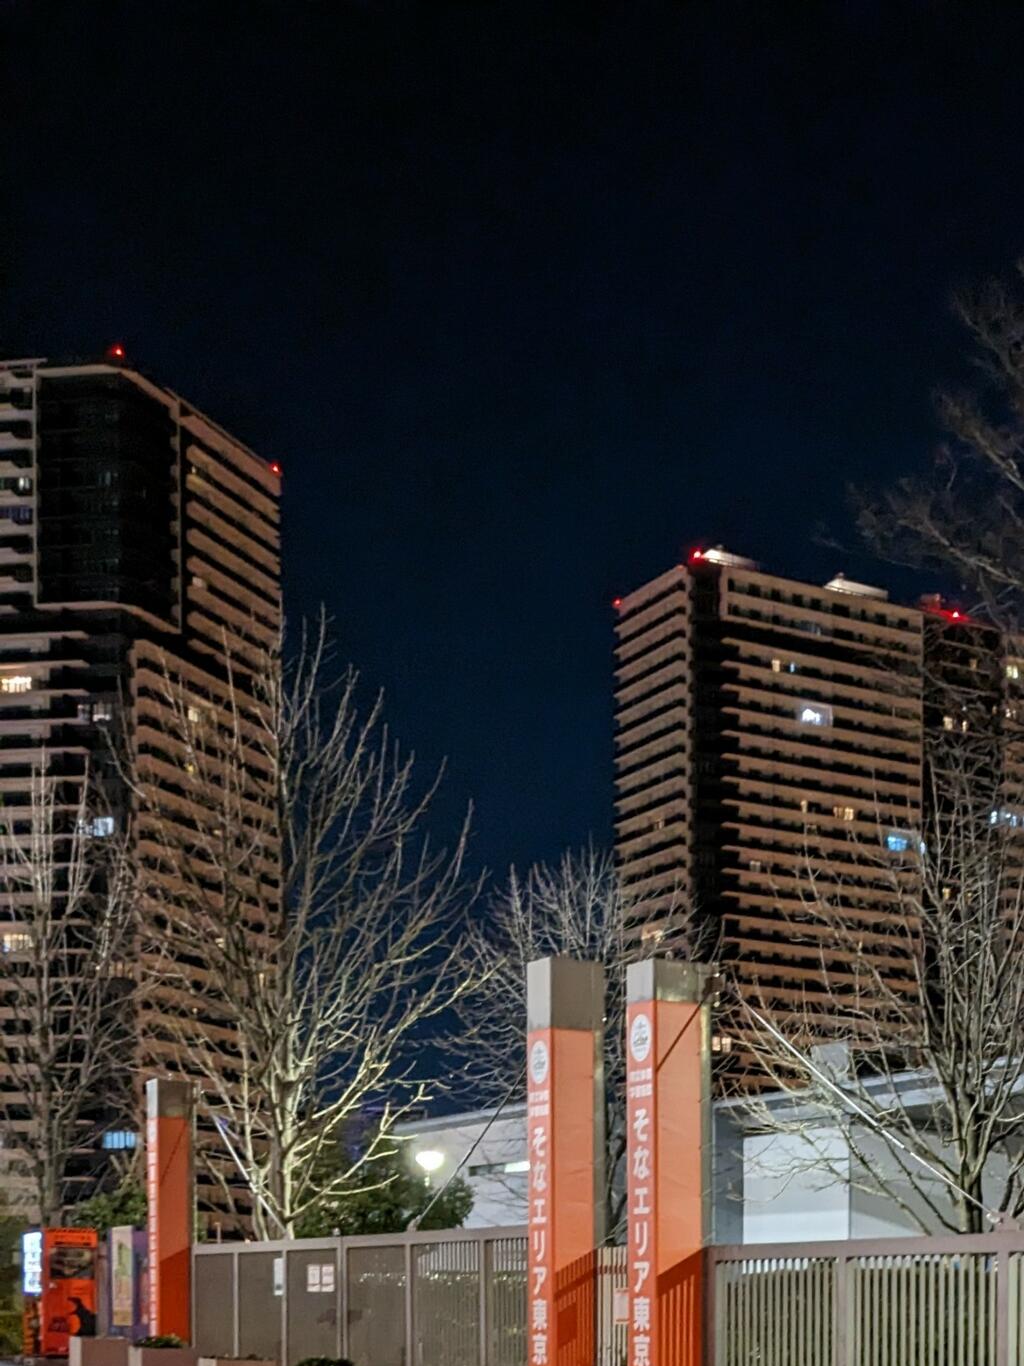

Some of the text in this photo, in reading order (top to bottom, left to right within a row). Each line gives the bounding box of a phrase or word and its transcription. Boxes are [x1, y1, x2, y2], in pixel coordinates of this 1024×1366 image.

[532, 1127, 548, 1365] そなエリア東京
